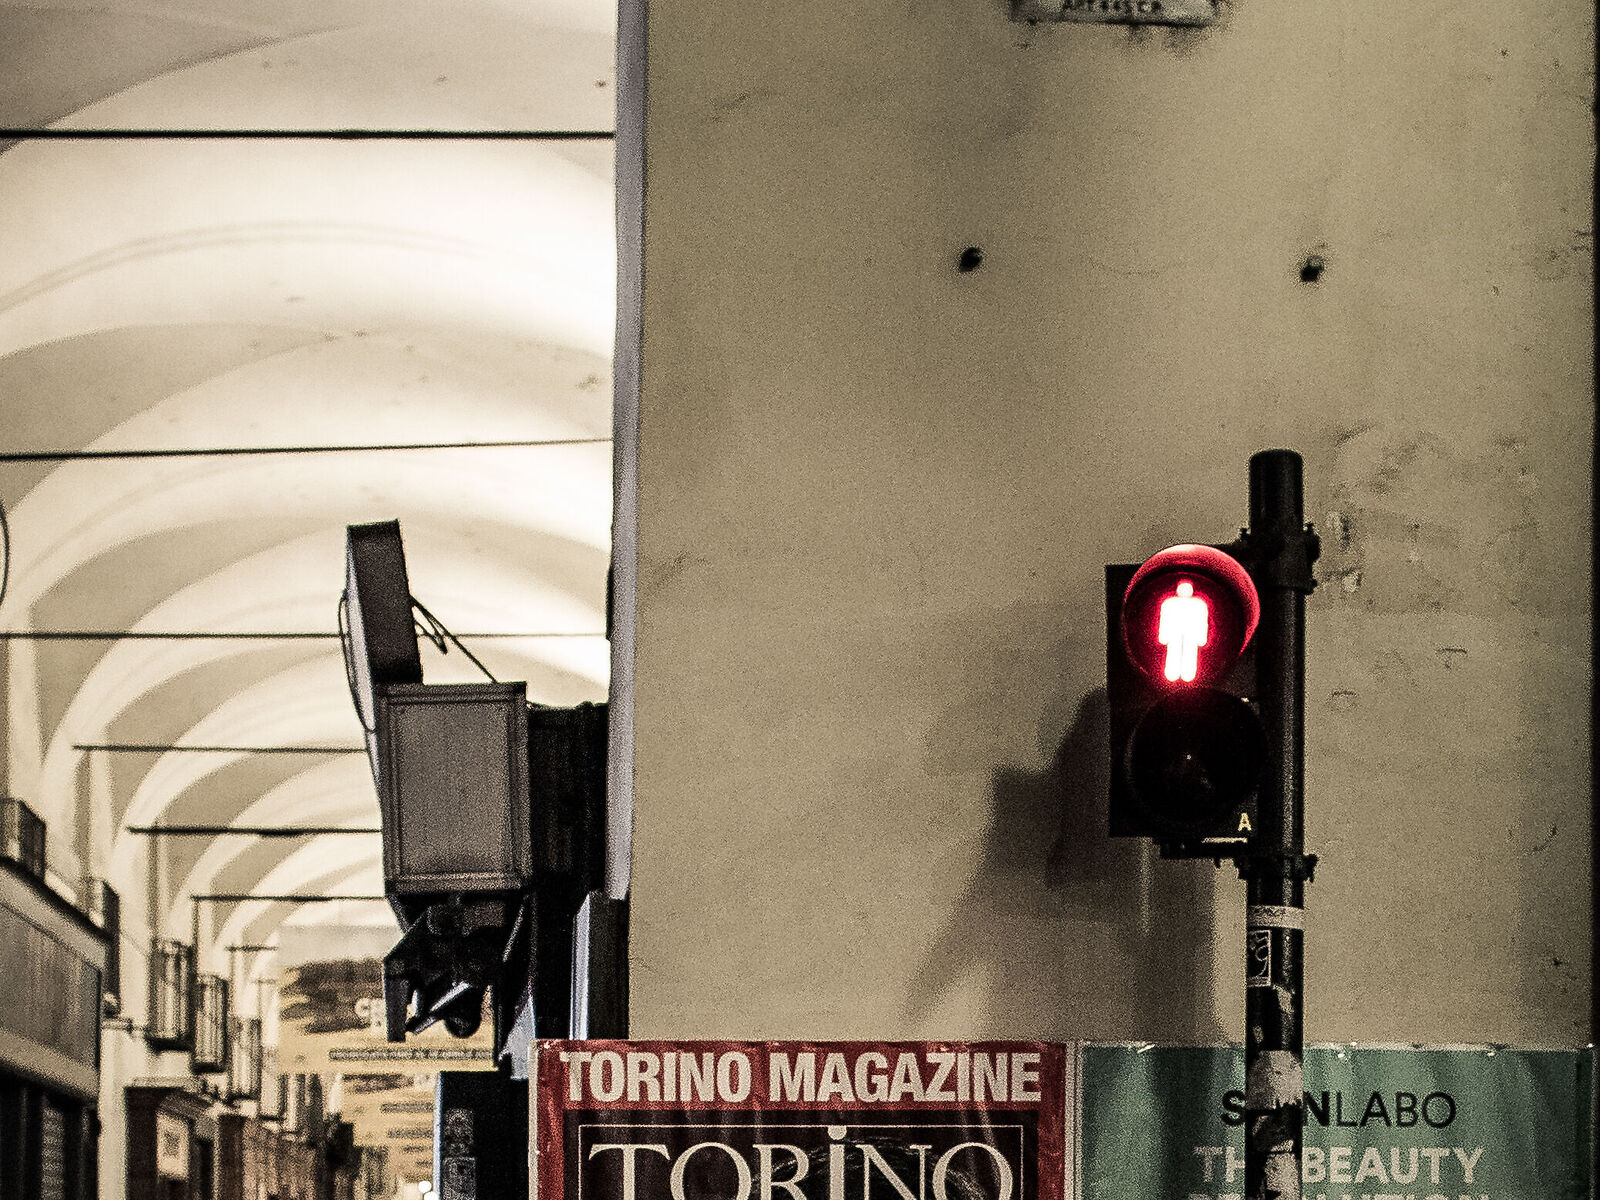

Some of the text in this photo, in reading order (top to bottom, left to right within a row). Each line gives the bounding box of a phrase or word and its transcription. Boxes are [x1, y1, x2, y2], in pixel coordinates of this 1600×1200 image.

[1237, 812, 1252, 832] A
[560, 1051, 1042, 1102] TORINO MAGAZINE
[1221, 1089, 1457, 1129] SNLABO
[1192, 1146, 1485, 1185] TH BEAUTY
